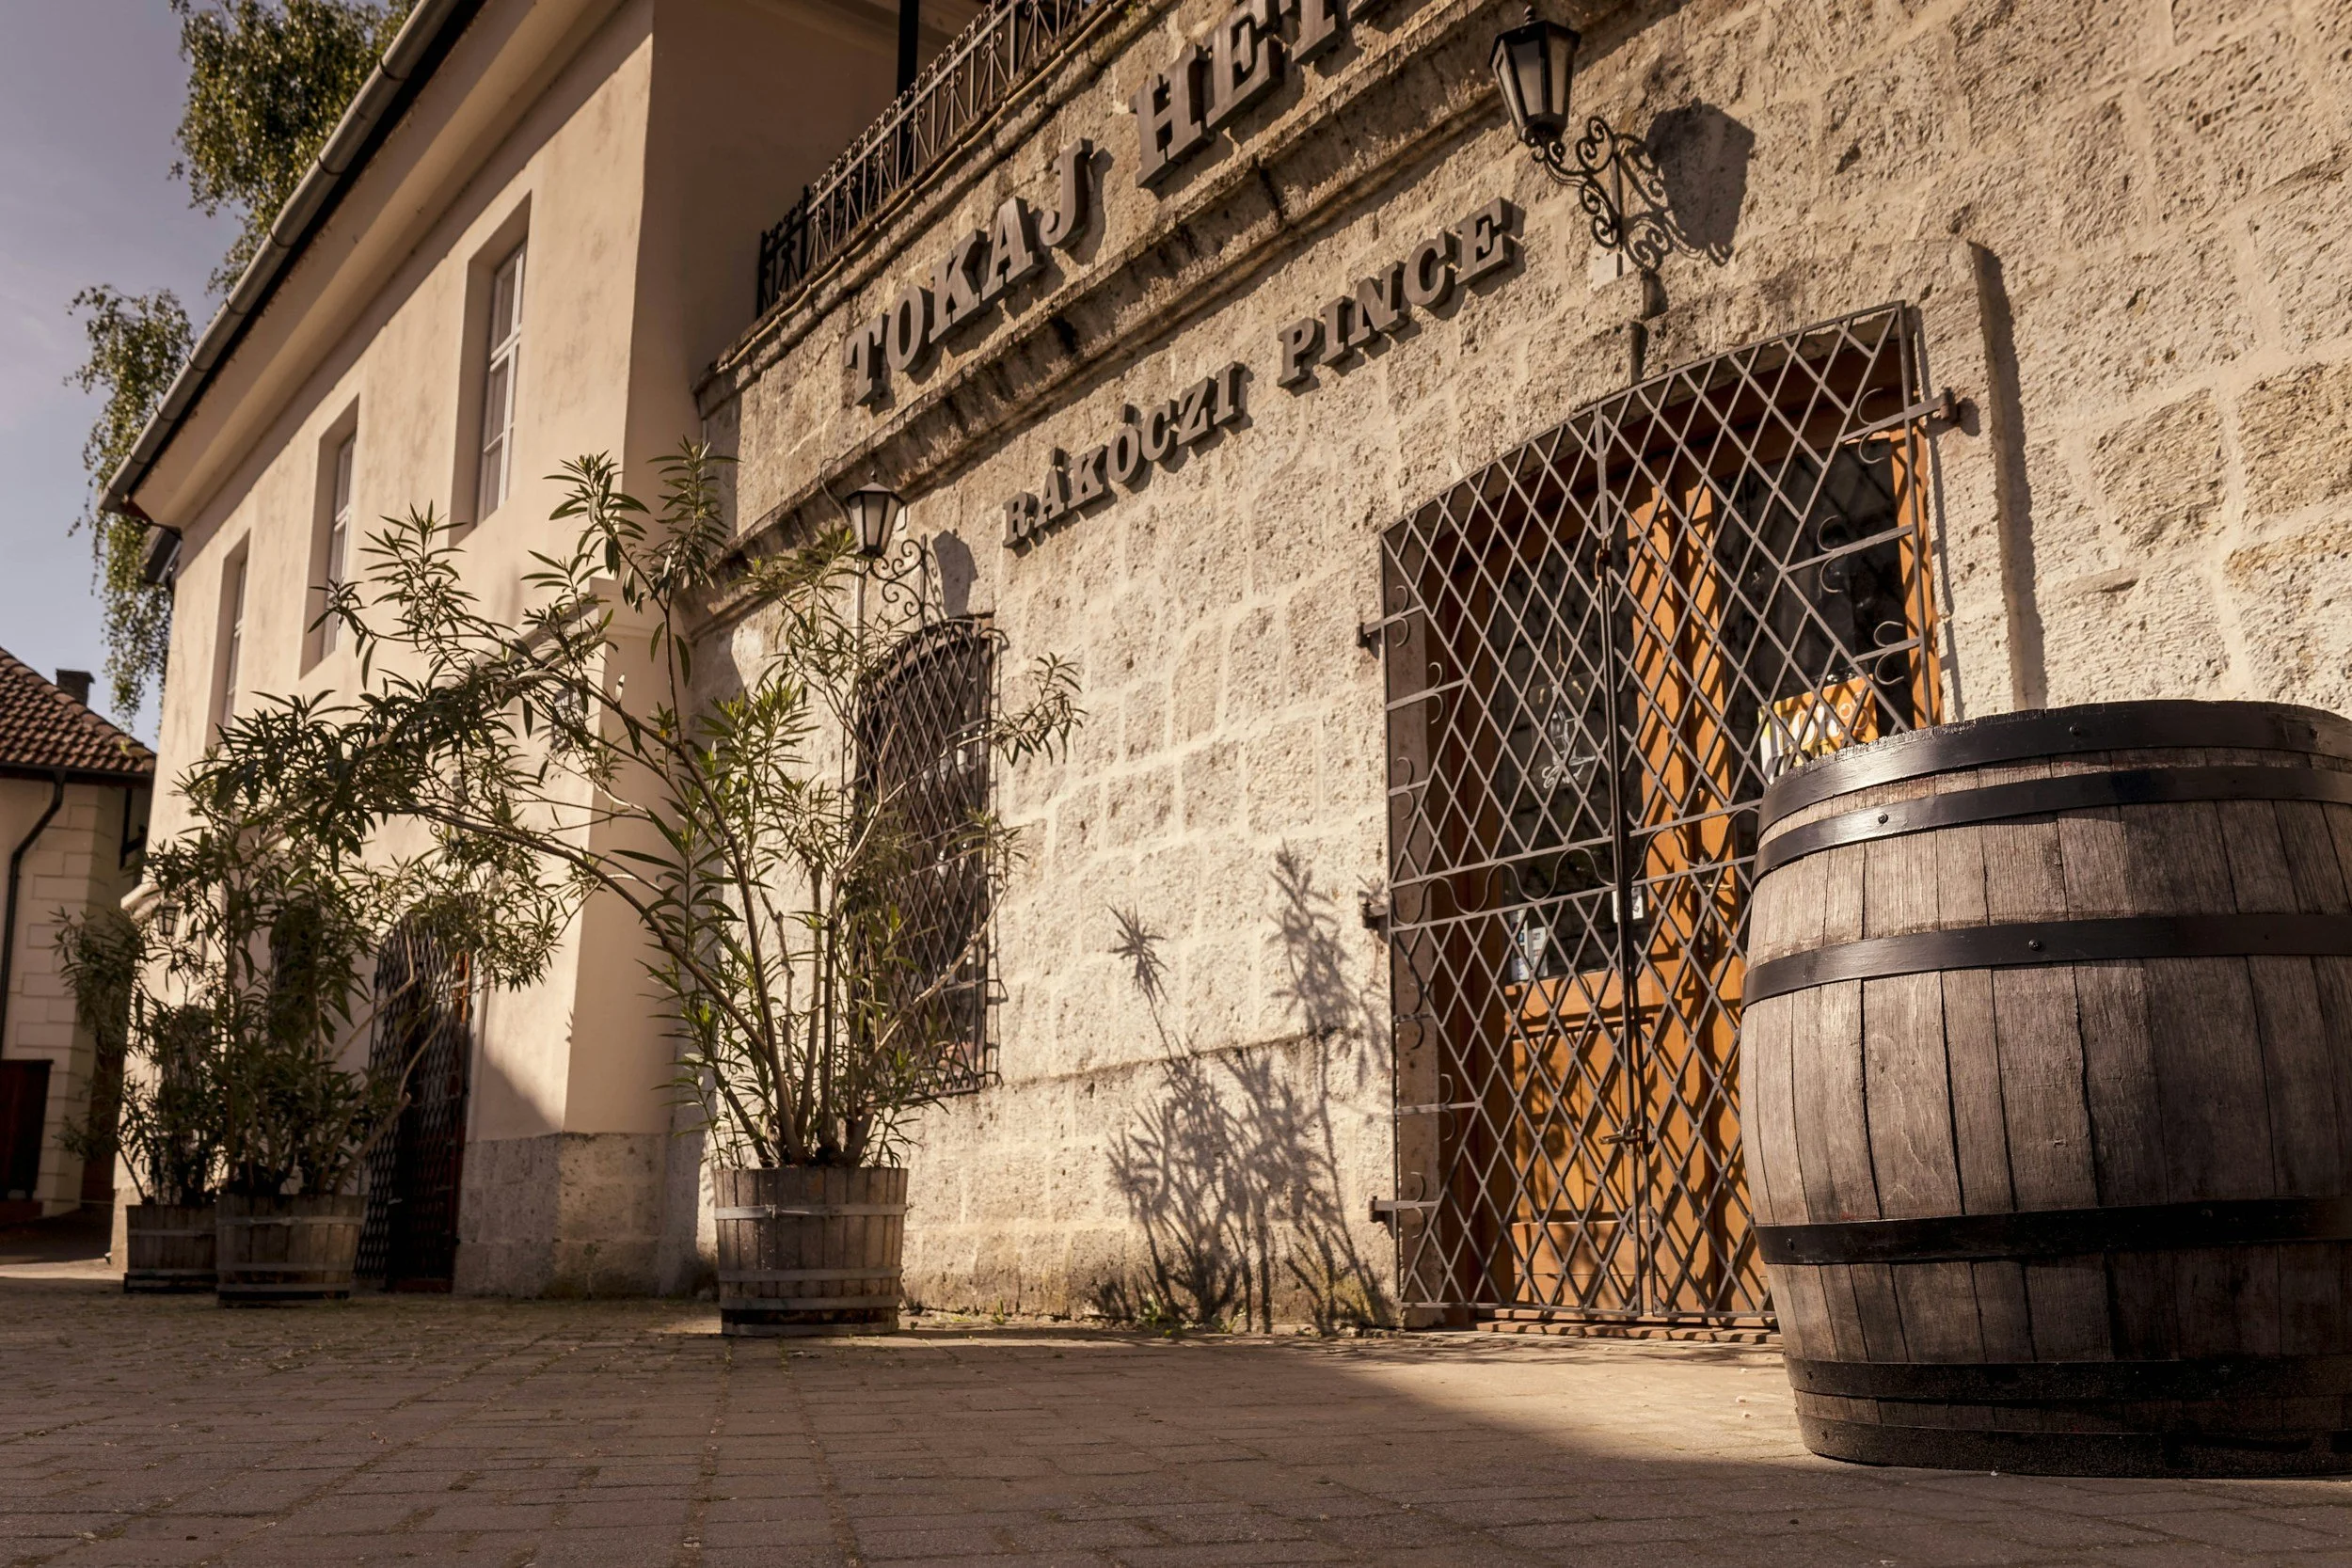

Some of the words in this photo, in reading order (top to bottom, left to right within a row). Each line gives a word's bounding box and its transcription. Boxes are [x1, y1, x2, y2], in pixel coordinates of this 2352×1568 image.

[846, 136, 1096, 406] TOKAJ
[1001, 361, 1245, 549] RÁKÓCZI
[1276, 196, 1512, 388] PINCE
